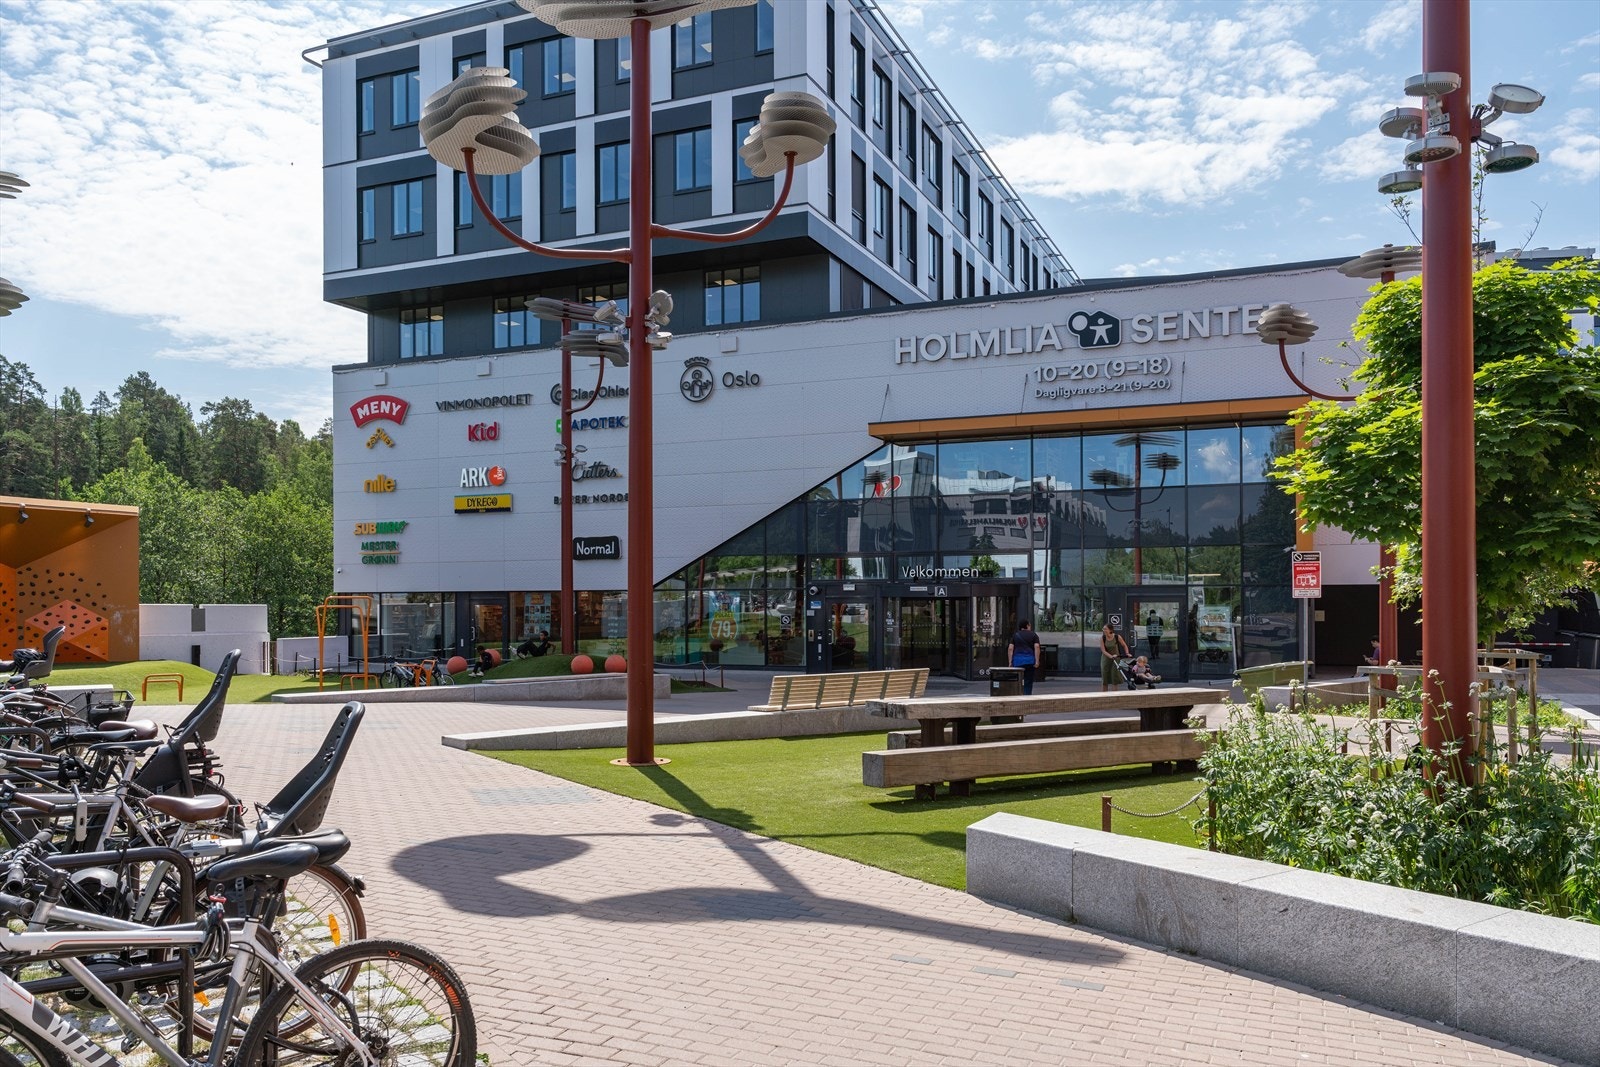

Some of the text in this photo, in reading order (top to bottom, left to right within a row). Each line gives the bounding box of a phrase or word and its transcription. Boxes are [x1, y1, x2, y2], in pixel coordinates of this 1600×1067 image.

[895, 302, 1289, 364] HOLMLIA SENTE
[1034, 355, 1172, 383] 10-20 (9-18)
[722, 370, 760, 388] Oslo
[1034, 378, 1171, 399] Dagligvare 8-21 (9-20)
[356, 400, 402, 420] MENY
[435, 393, 534, 412] VINMONOPOLET
[468, 421, 498, 441] Kid
[571, 416, 626, 430] APOTEK
[460, 467, 488, 488] ARK
[571, 461, 618, 482] Cutters
[363, 473, 396, 493] nille
[554, 495, 588, 505] BER
[353, 521, 407, 536] SUBWAY
[361, 541, 398, 551] MESTER
[576, 540, 615, 556] Normal
[361, 555, 398, 565] GRØNN
[901, 565, 979, 578] Velkommen
[938, 587, 946, 596] A
